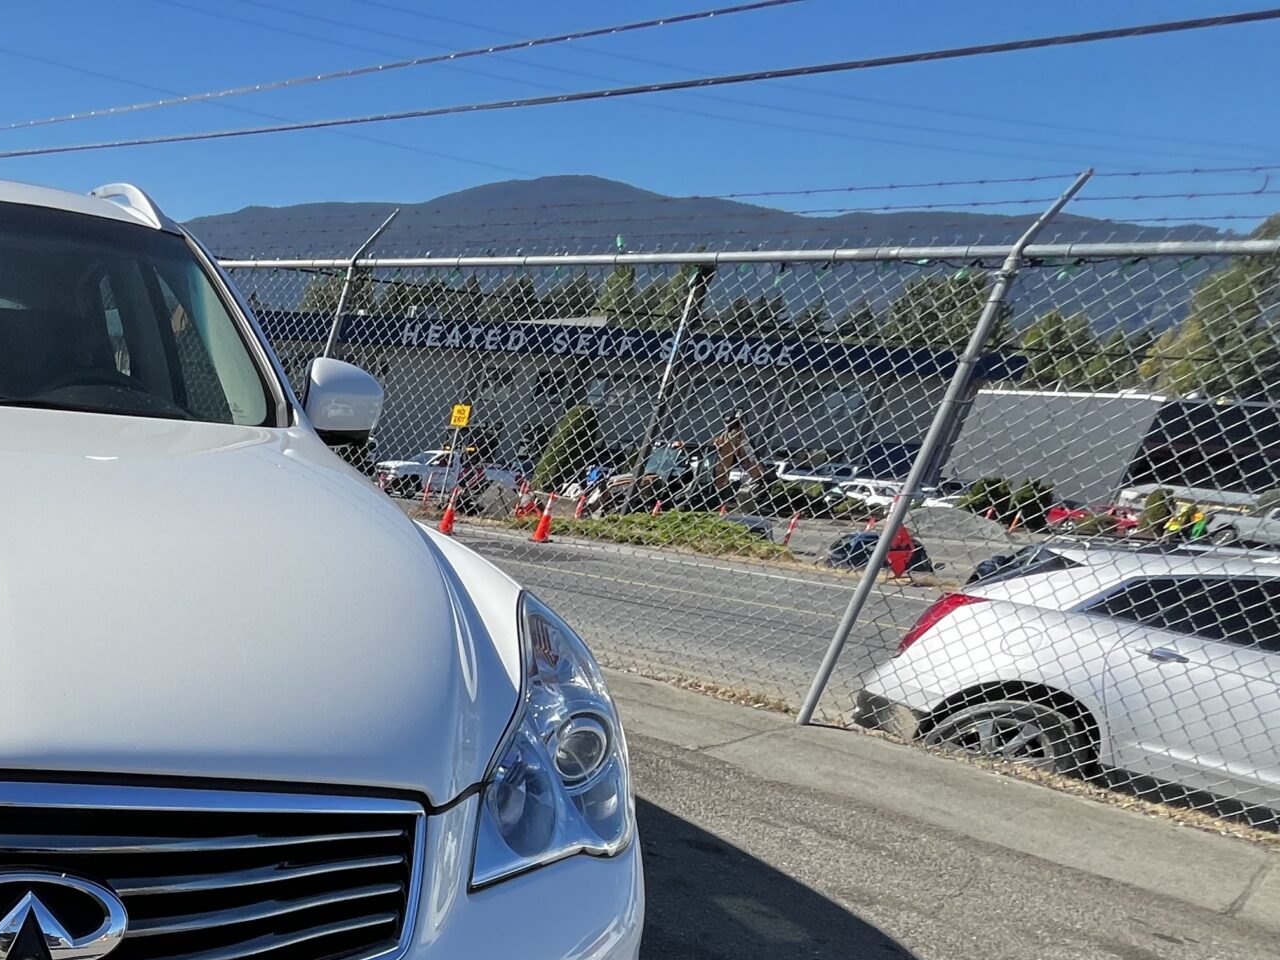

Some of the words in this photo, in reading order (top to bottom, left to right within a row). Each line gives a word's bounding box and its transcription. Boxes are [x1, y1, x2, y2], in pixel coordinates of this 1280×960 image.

[401, 323, 524, 350] HEATED
[552, 331, 635, 356] SELF
[659, 337, 794, 366] SORAGE
